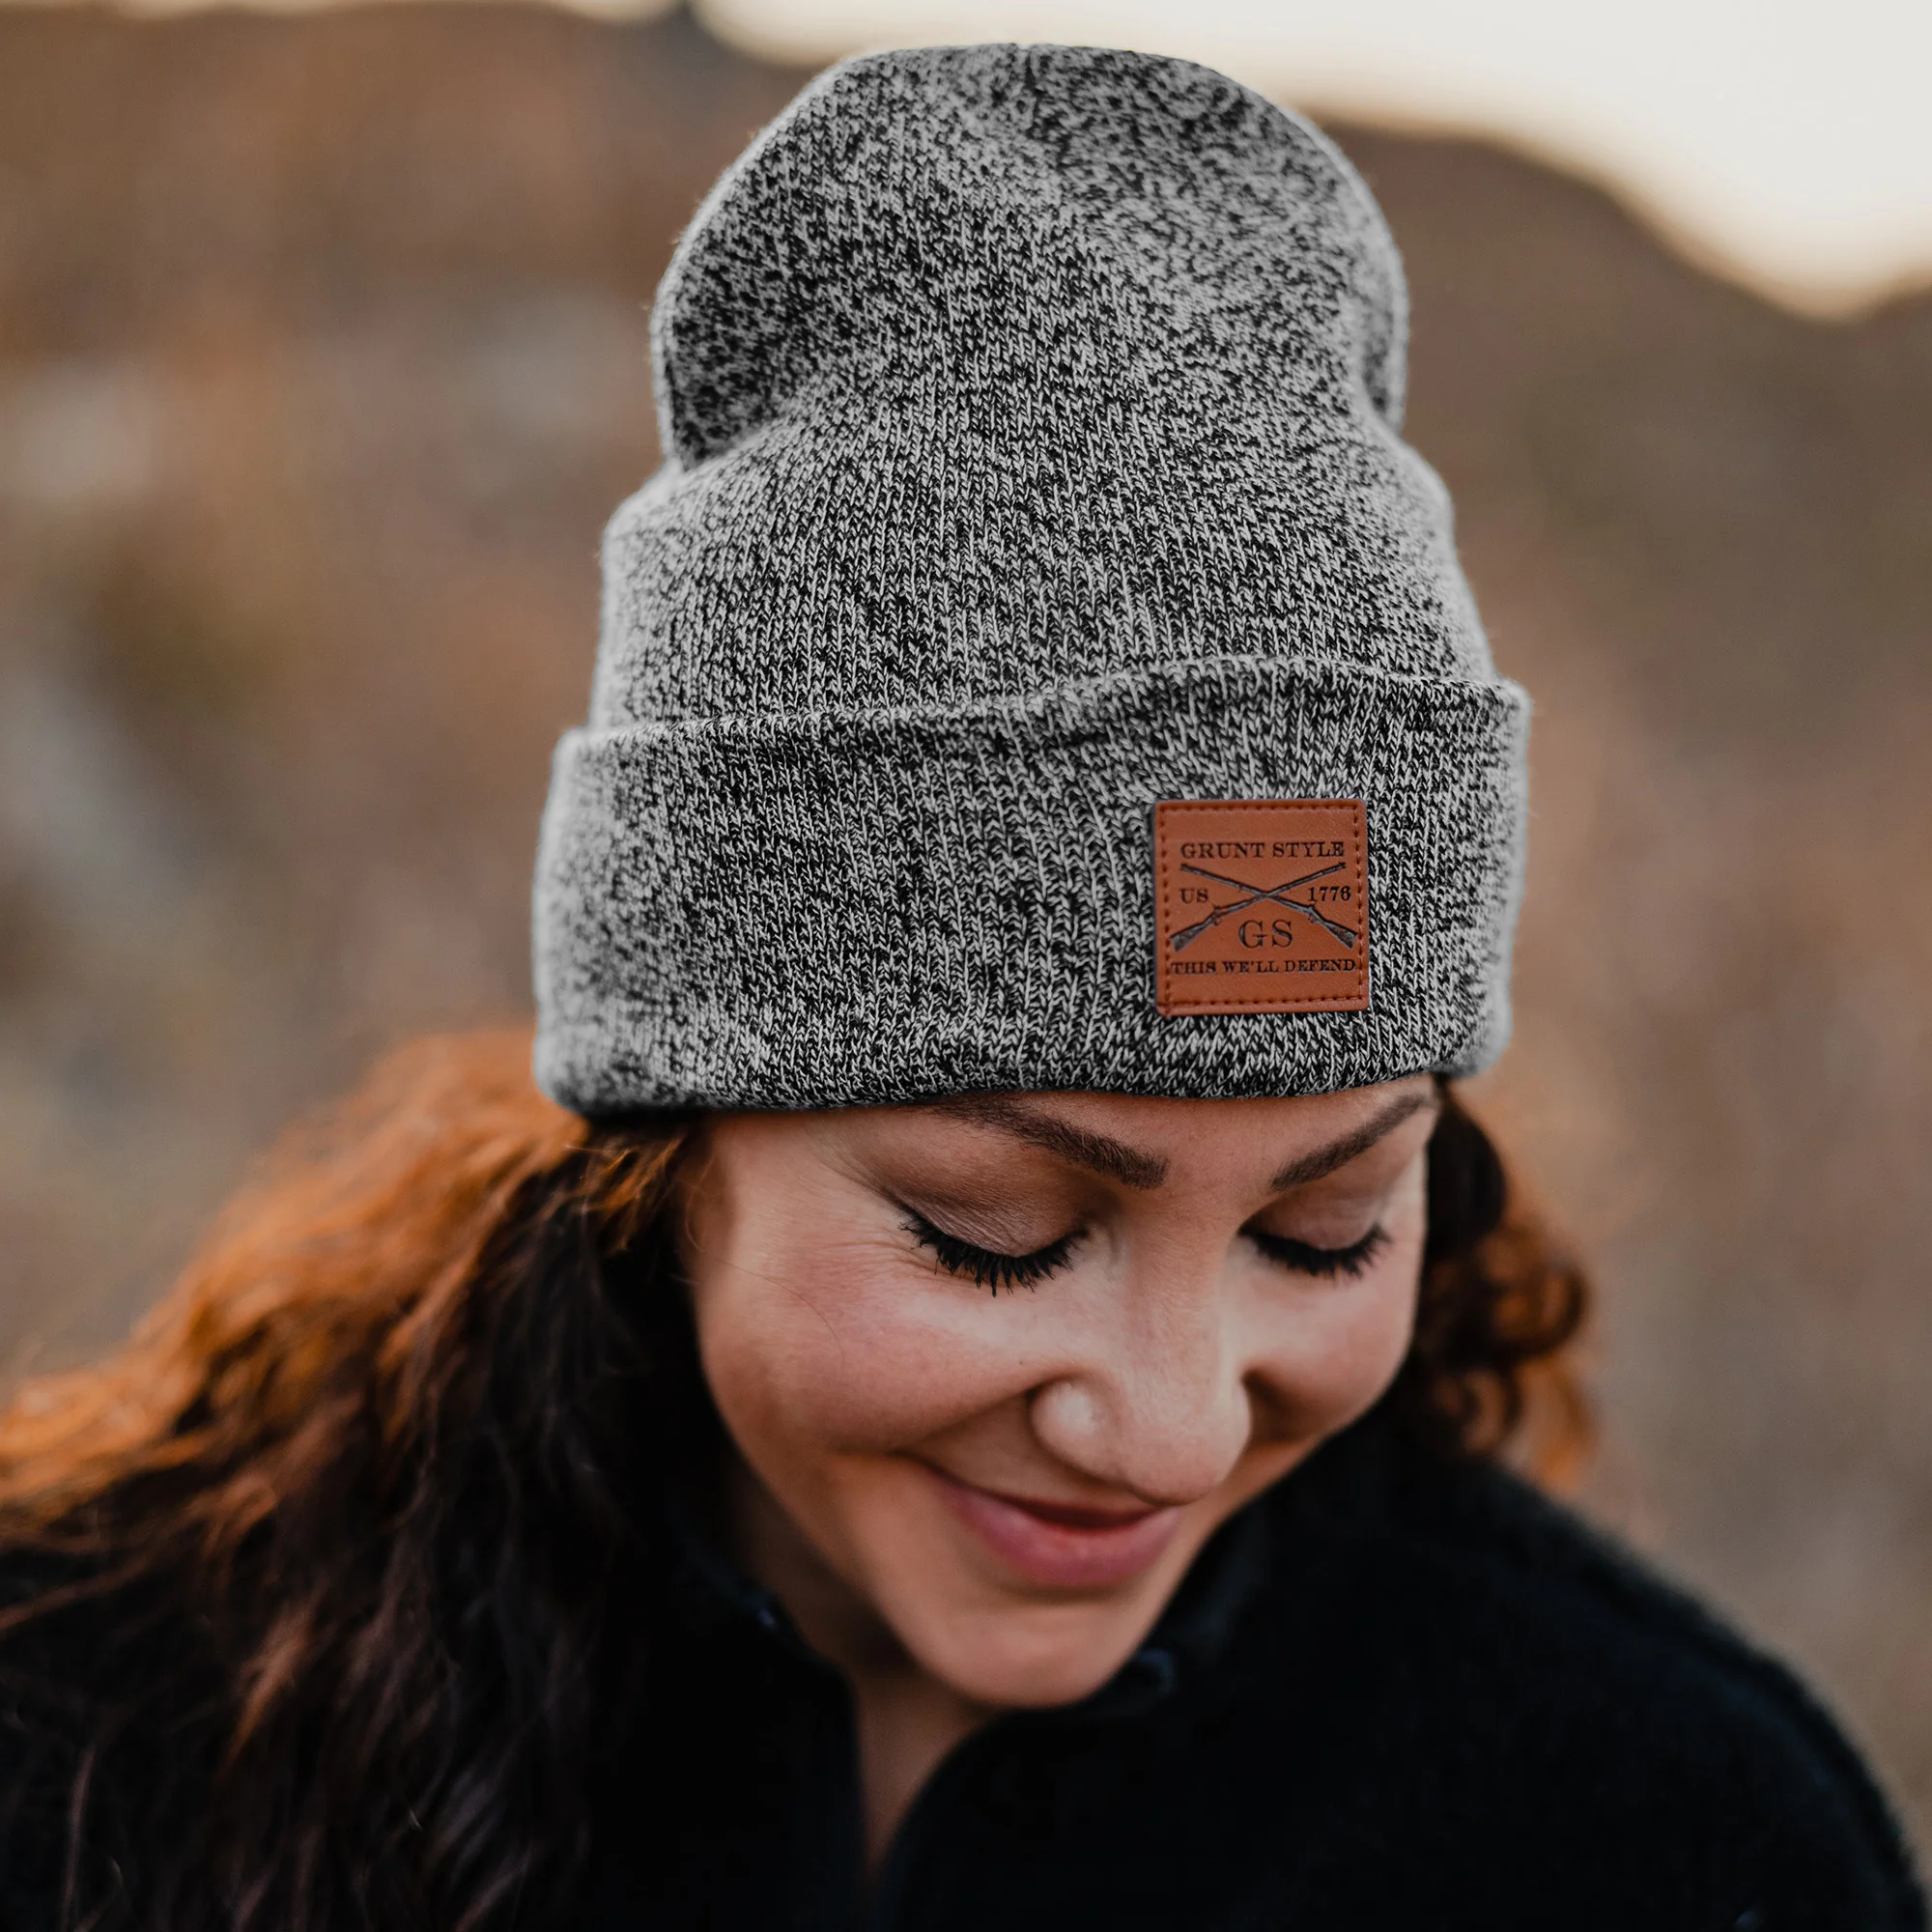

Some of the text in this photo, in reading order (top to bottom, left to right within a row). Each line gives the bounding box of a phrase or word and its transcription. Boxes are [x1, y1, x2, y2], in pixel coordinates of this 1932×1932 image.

[1180, 841, 1345, 859] GRUNT STYLE
[1180, 888, 1208, 904] US
[1308, 886, 1351, 902] 1776
[1238, 920, 1293, 949] GS
[1171, 958, 1356, 975] THIS WE'LL DEFEND
